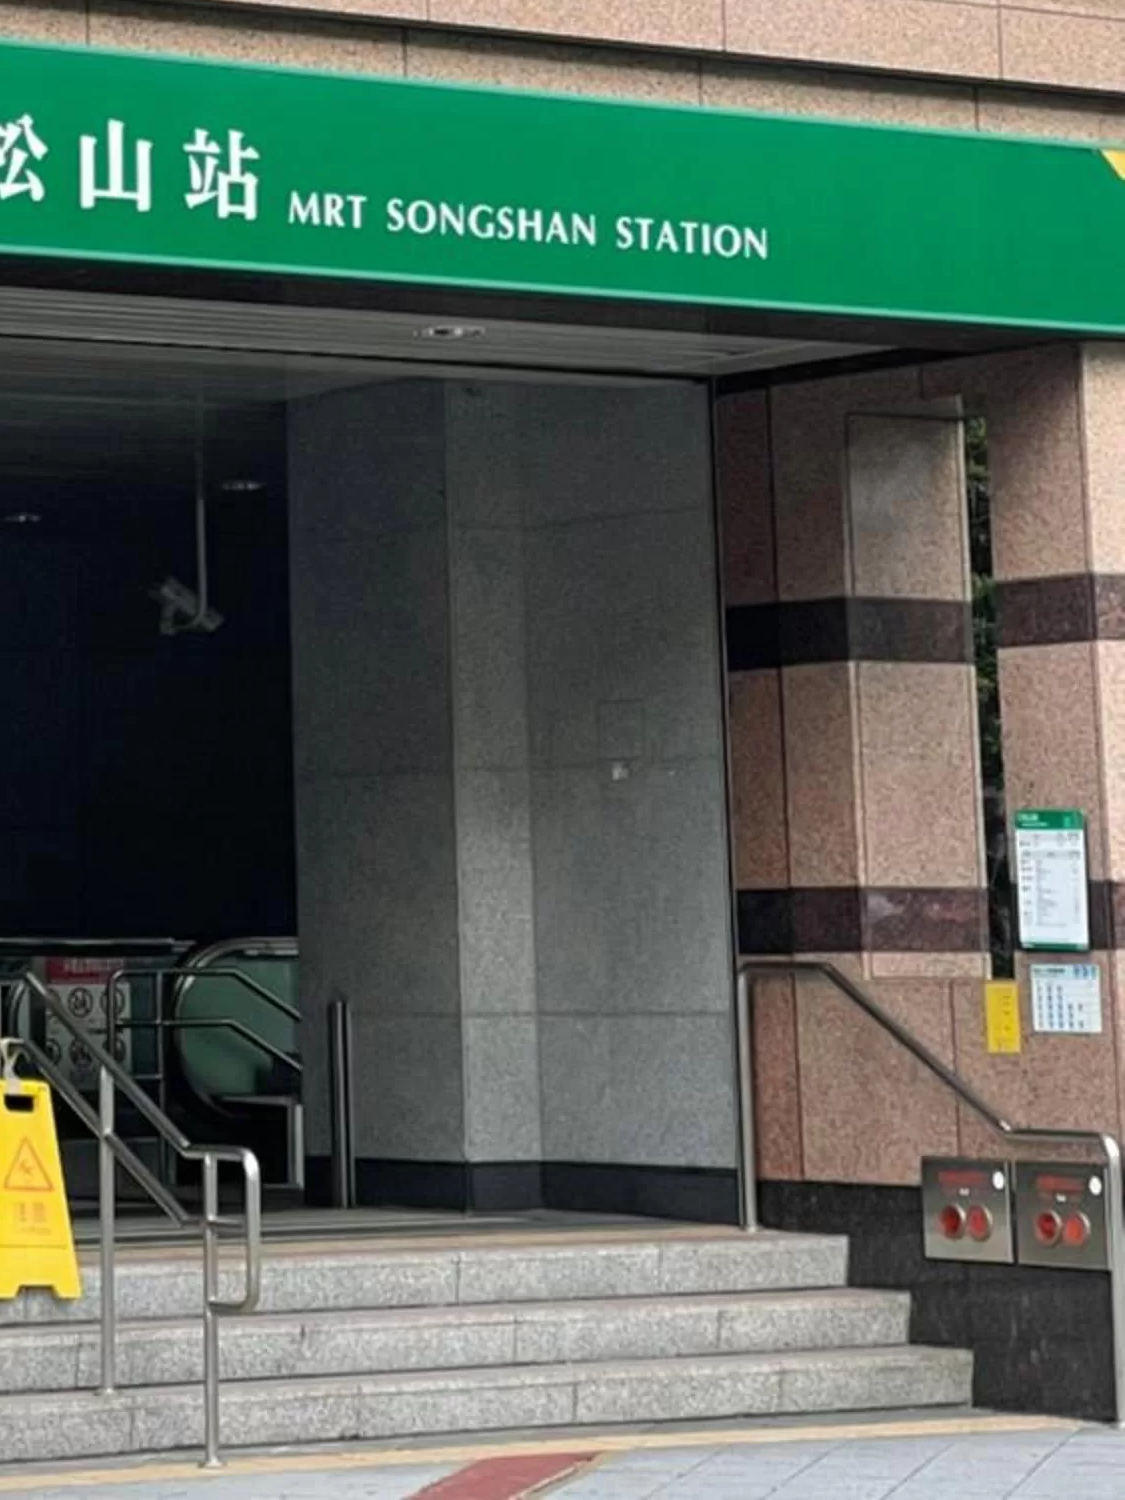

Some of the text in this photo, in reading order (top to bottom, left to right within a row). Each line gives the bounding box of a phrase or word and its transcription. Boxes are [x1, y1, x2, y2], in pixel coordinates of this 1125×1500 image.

[288, 190, 769, 260] MRT SONGSHAN STATION
